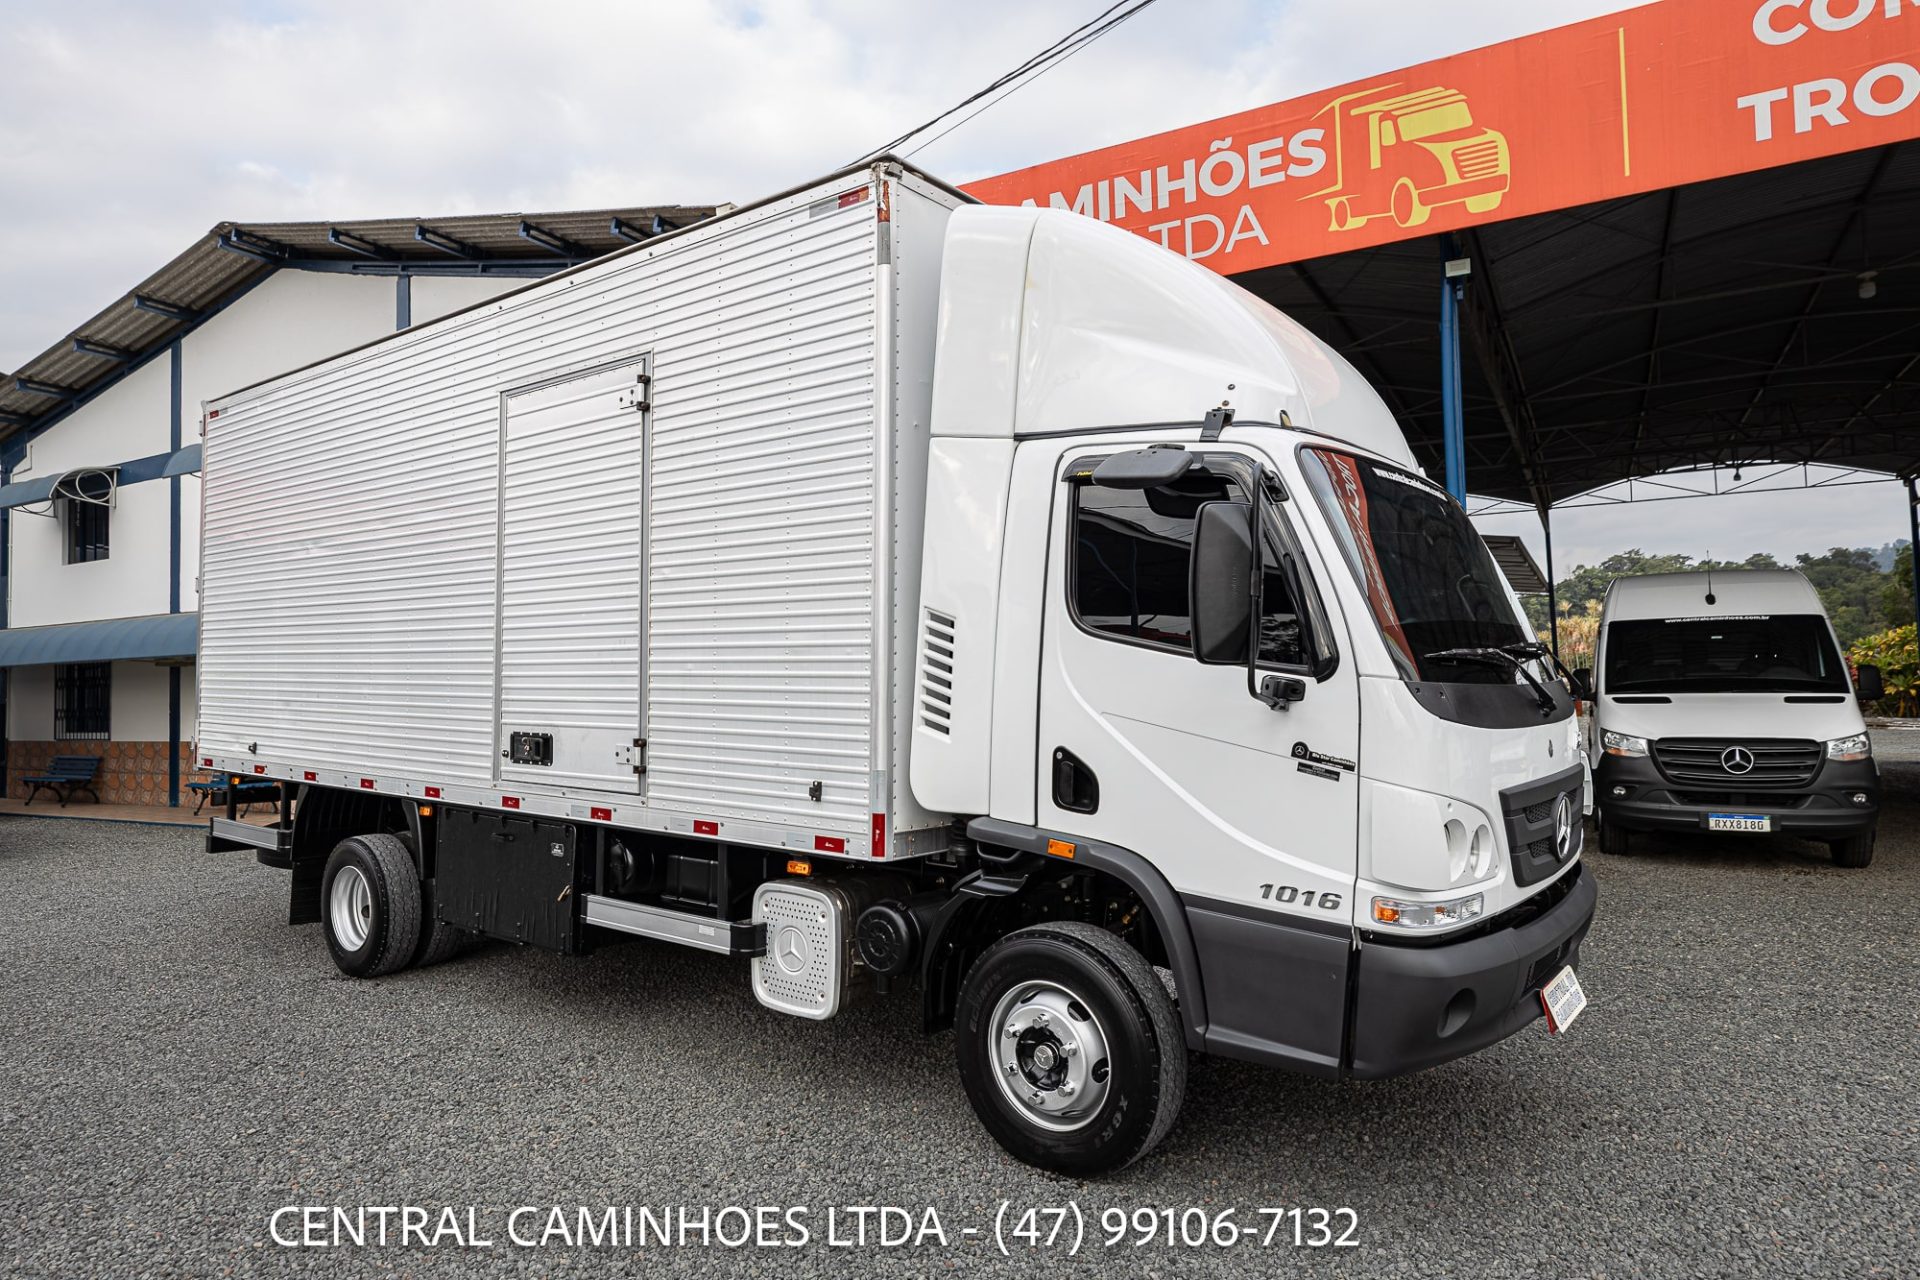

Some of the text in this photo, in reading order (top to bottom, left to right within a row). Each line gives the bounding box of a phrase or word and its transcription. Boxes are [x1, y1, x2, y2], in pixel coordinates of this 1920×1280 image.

[1737, 62, 1920, 142] TRO
[1125, 204, 1270, 260] TDA
[1259, 883, 1342, 910] 1016
